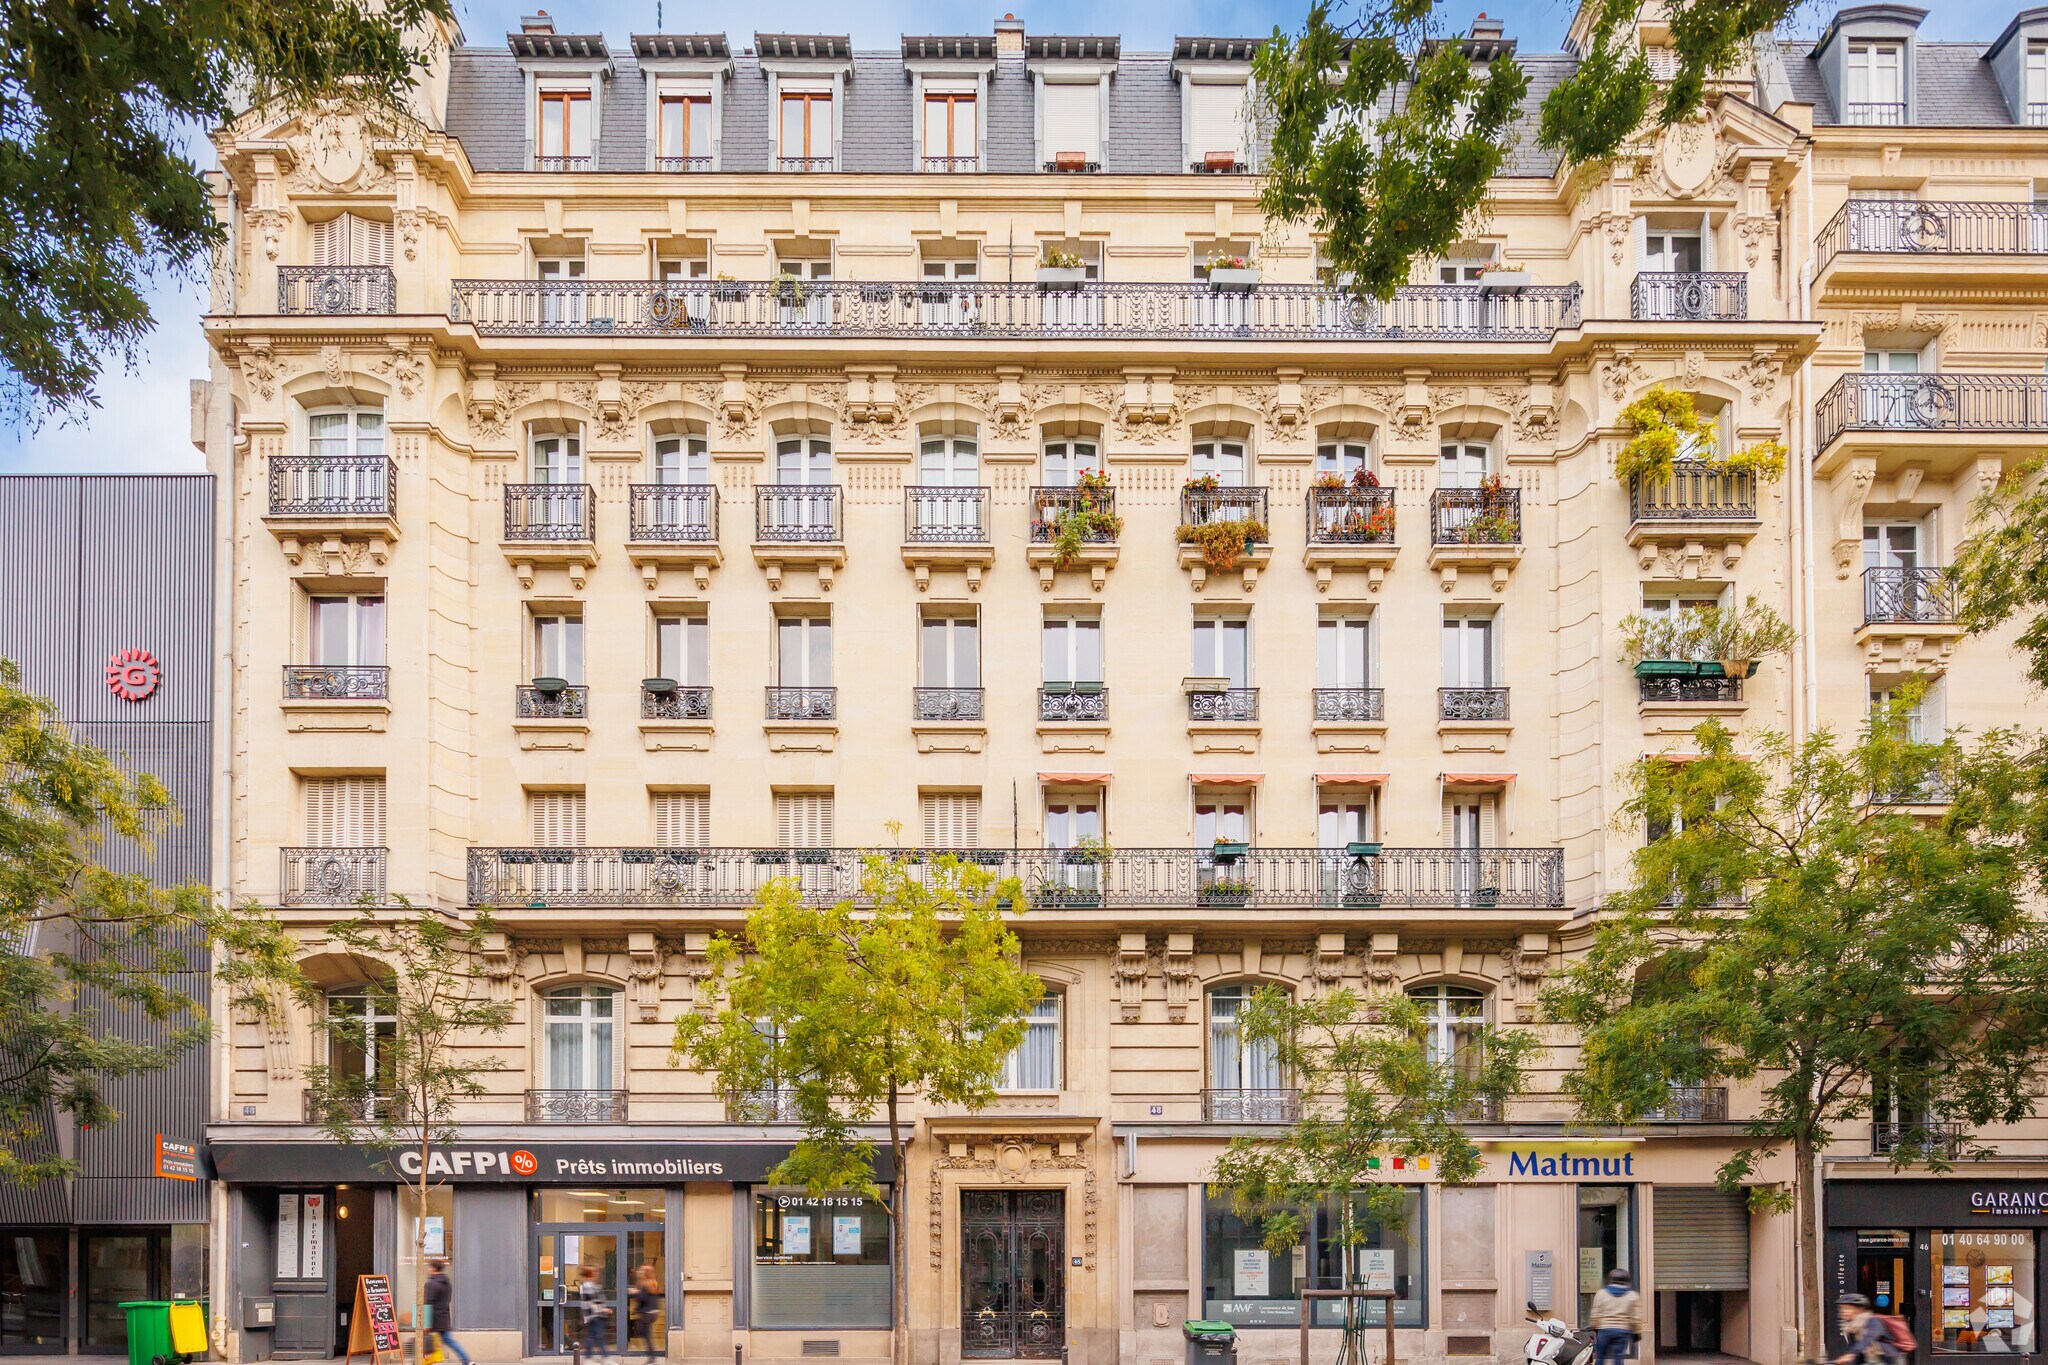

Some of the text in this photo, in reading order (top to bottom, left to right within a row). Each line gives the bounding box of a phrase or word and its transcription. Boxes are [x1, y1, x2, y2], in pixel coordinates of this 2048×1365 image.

[1151, 1106, 1162, 1114] 48
[162, 1142, 188, 1153] CAFPI
[400, 1151, 511, 1175] CAFPI
[556, 1159, 723, 1175] Prêts immobiliers
[1509, 1151, 1634, 1176] Matmut
[792, 1197, 863, 1206] 01 42 18 15 15
[1991, 1207, 2041, 1215] immobilier
[1942, 1233, 2025, 1246] 01 40 64 90 00
[1233, 1304, 1253, 1312] AMF
